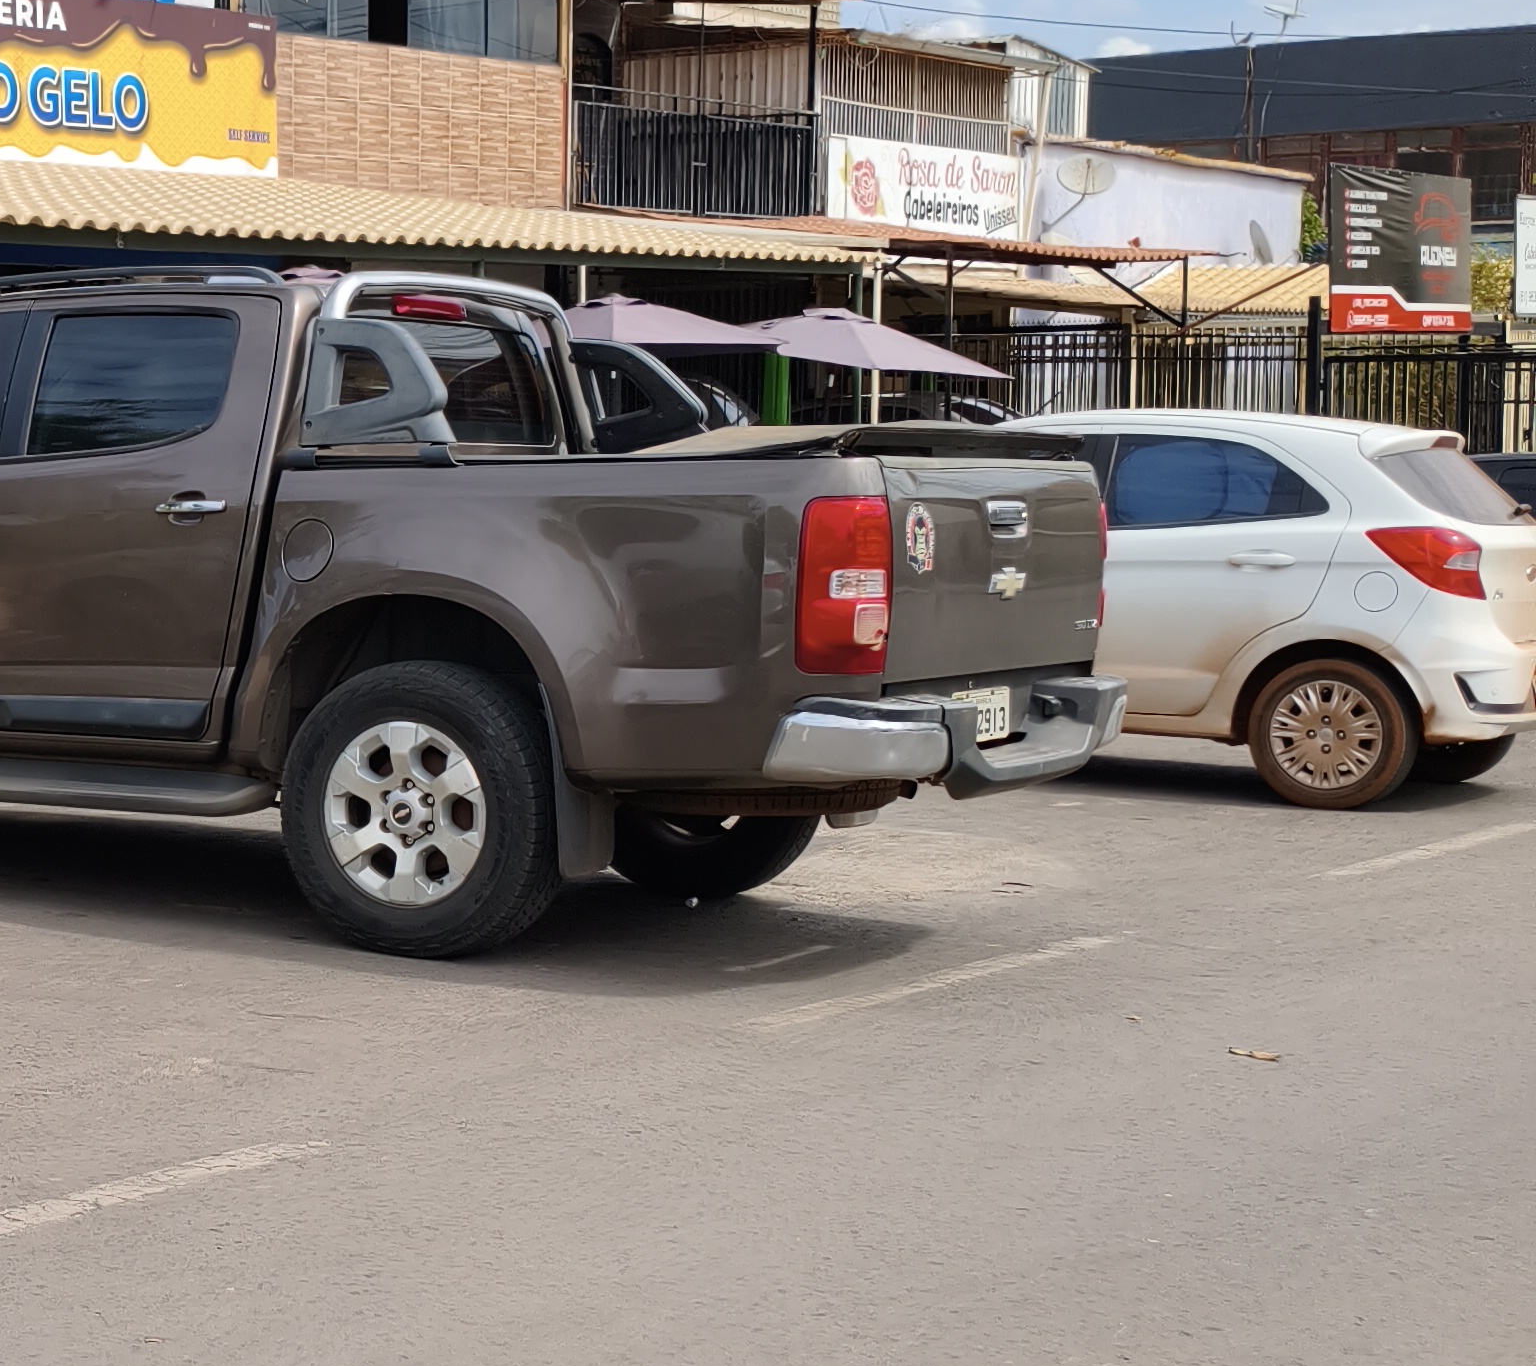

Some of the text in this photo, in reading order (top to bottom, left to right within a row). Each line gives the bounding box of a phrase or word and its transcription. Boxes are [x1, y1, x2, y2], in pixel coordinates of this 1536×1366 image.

[28, 66, 151, 133] GELO
[898, 147, 1016, 198] Rosa de Saron
[903, 185, 1017, 232] Cabeleireiros Unissex
